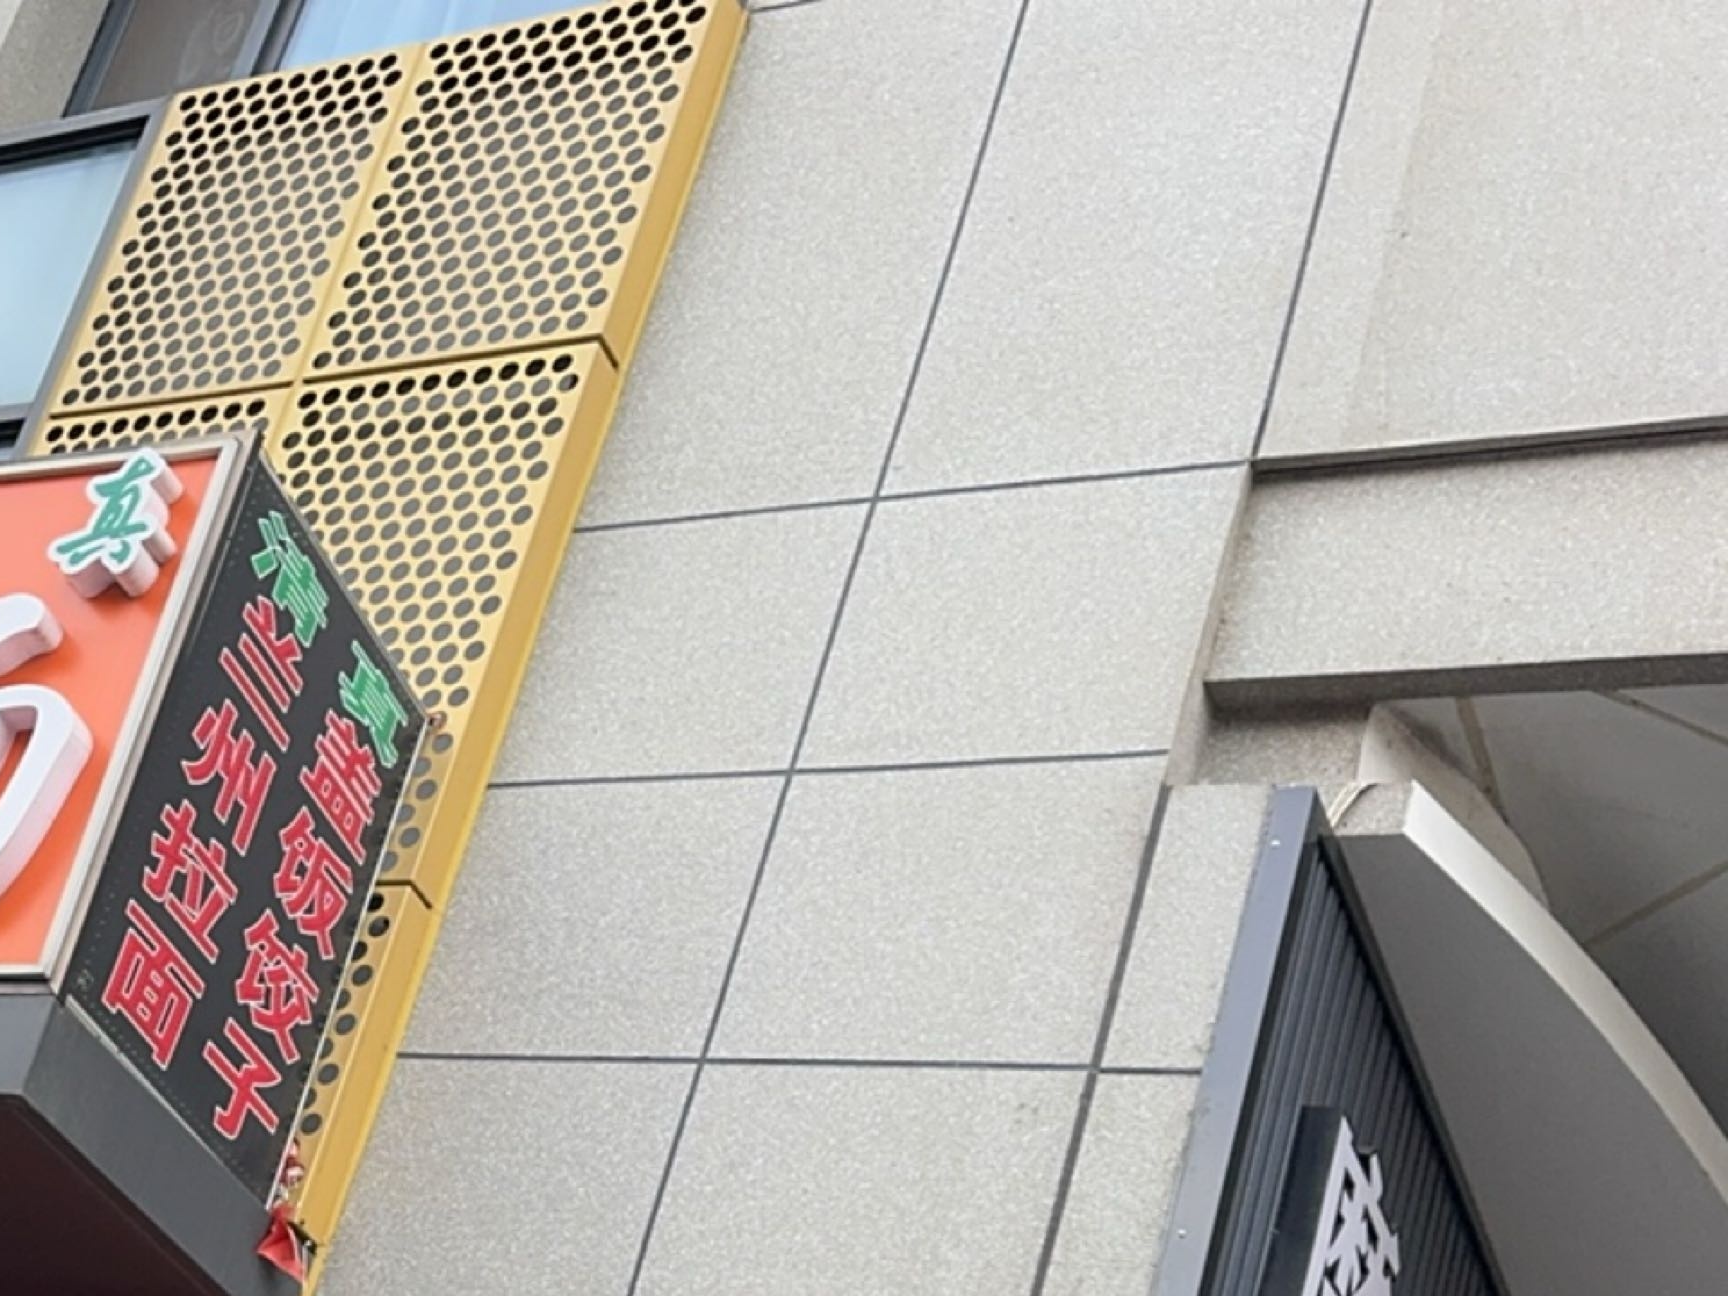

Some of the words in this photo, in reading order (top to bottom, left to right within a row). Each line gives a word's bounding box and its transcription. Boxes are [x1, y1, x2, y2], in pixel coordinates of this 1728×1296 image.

[48, 449, 168, 578] 真
[100, 595, 308, 1072] 兰州拉面
[201, 708, 384, 1142] 盖饭饺子
